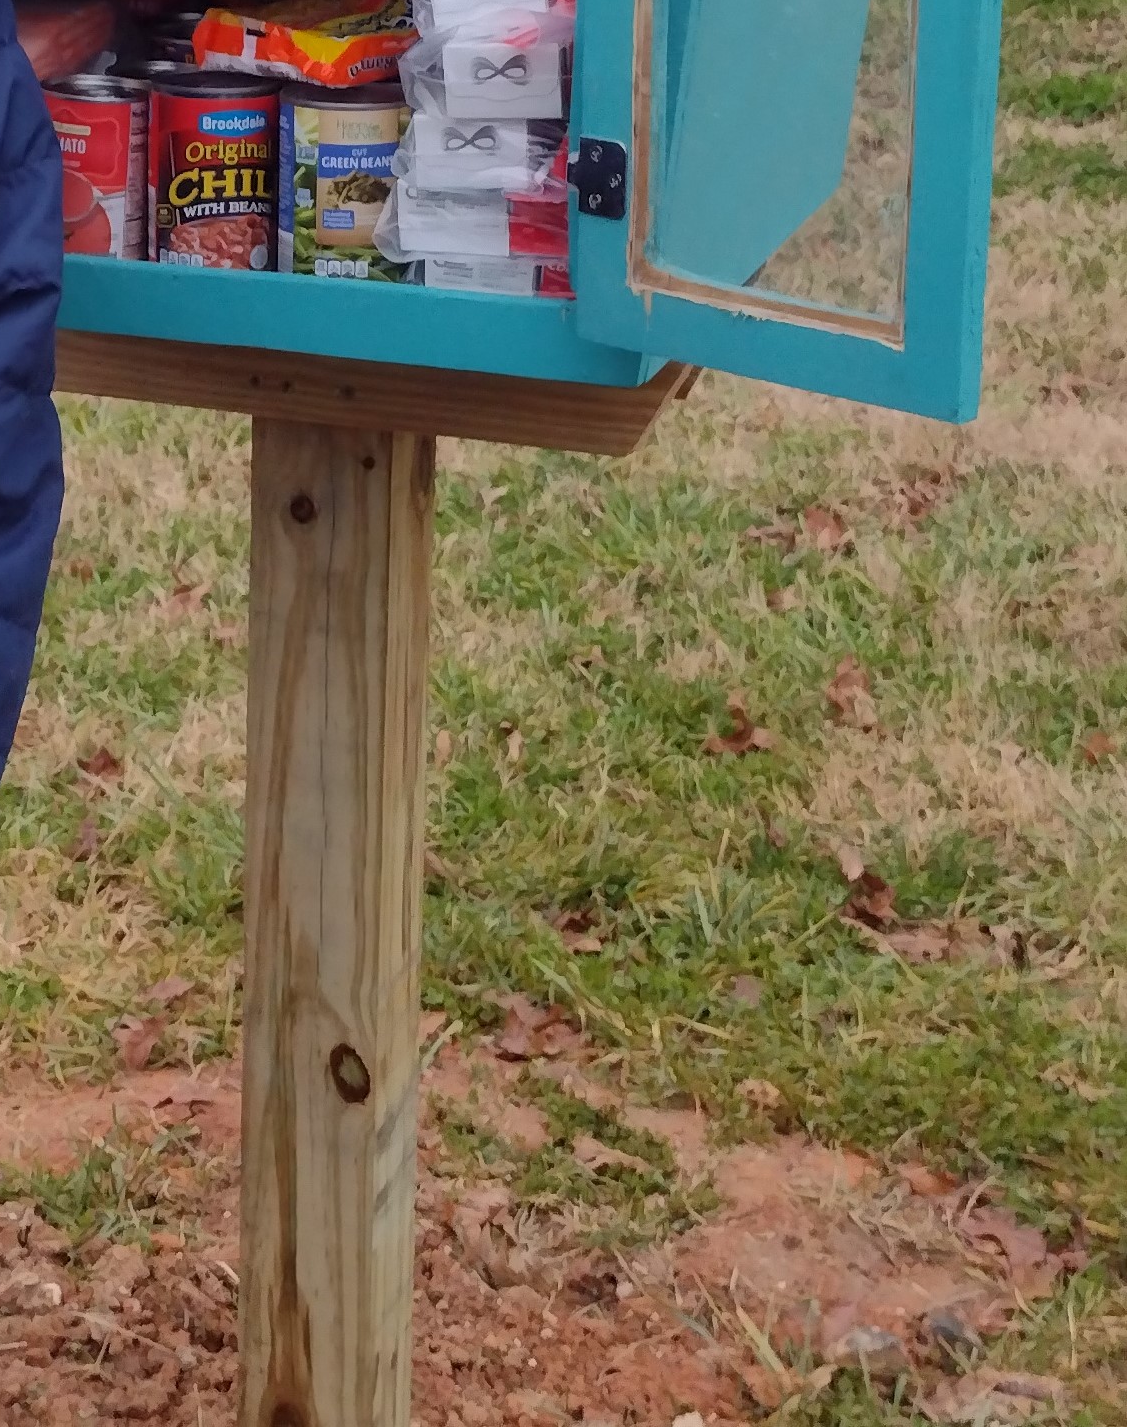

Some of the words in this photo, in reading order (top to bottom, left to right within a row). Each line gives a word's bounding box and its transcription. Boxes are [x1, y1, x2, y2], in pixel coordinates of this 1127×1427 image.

[202, 115, 266, 131] Brookdale
[321, 157, 358, 169] GREEN
[184, 202, 225, 218] WITH
